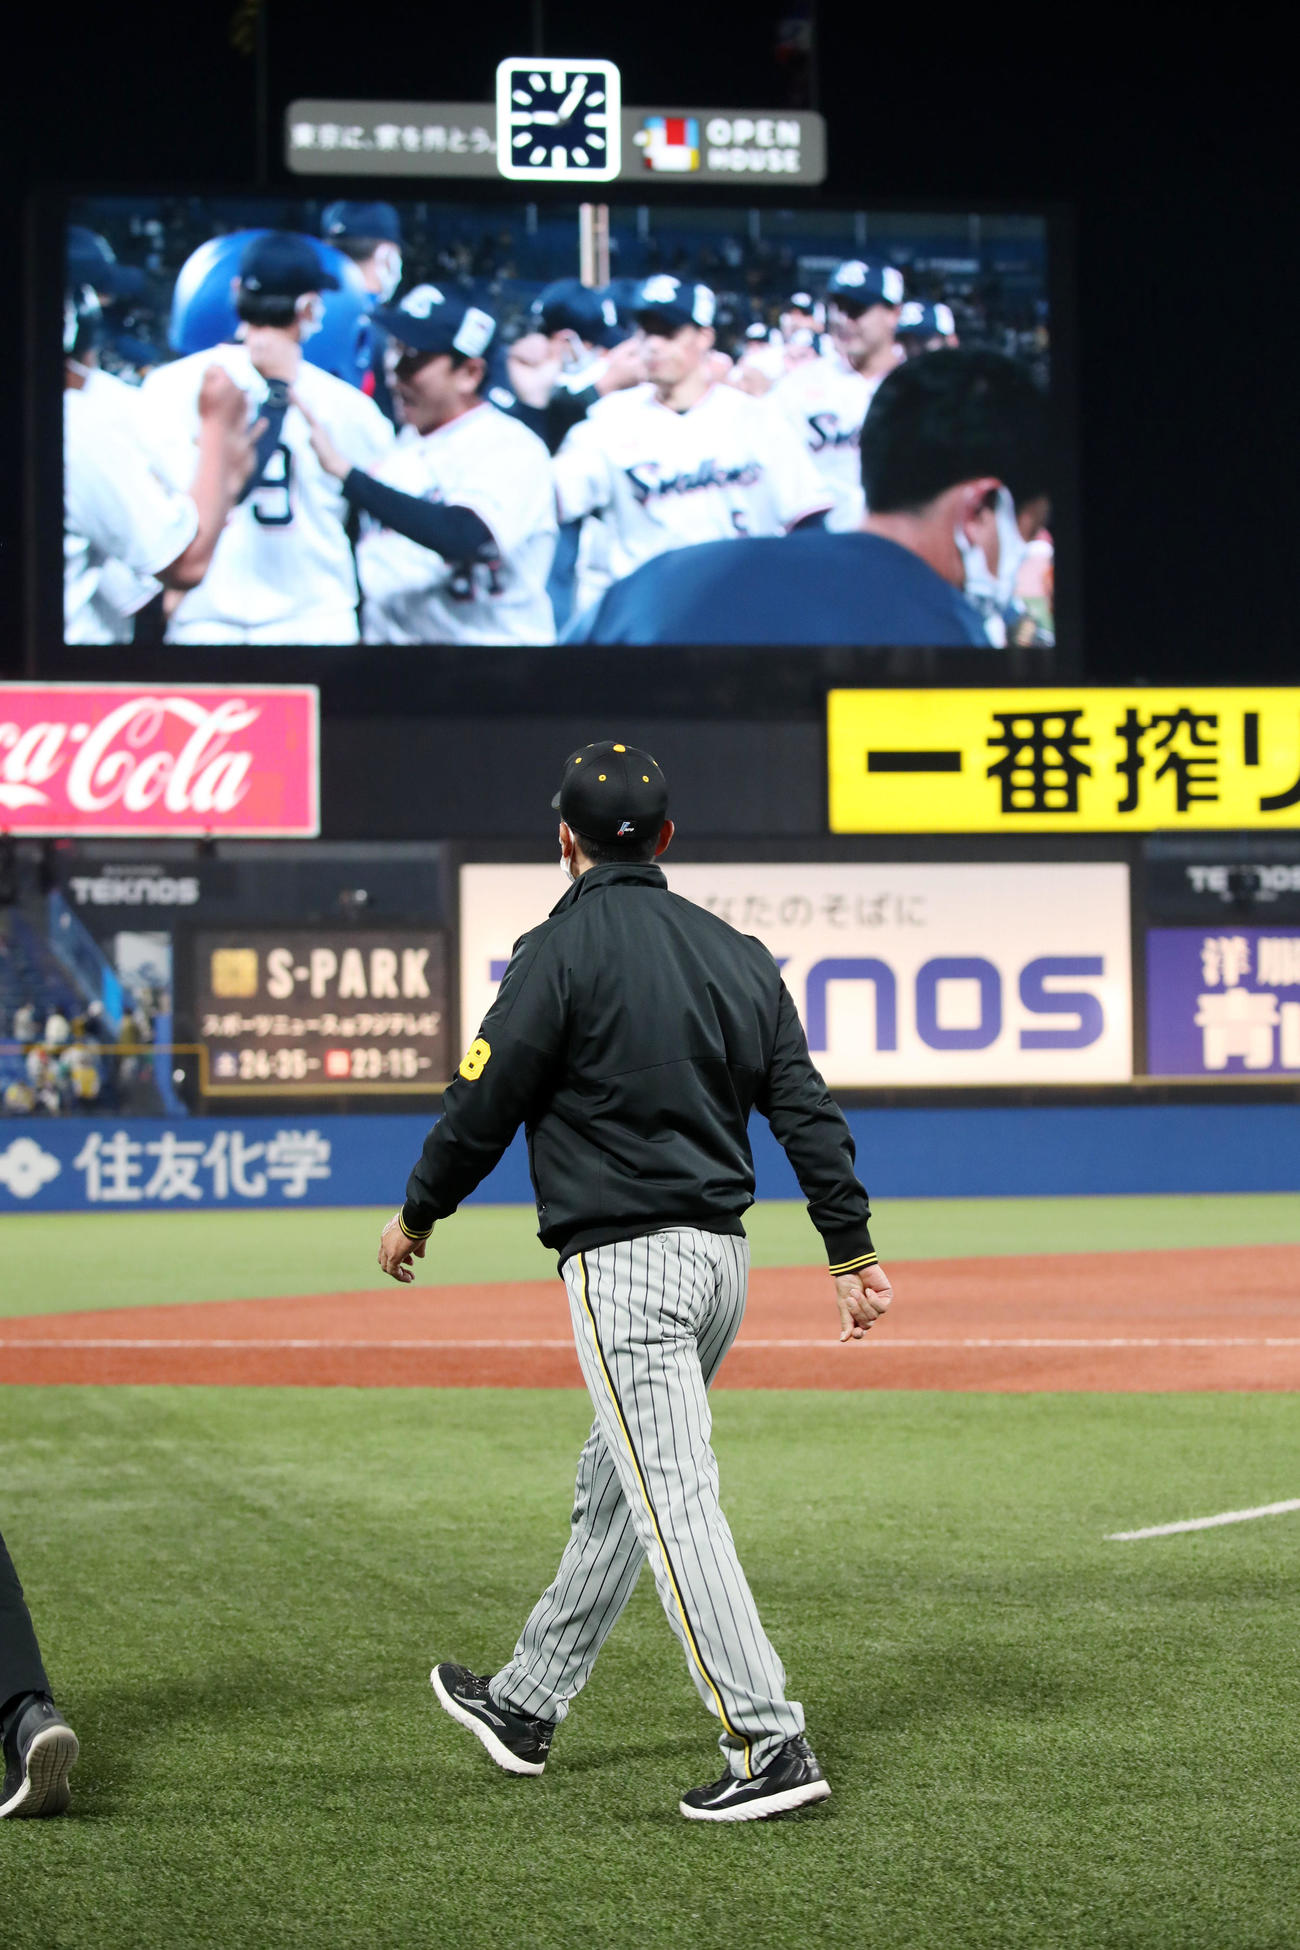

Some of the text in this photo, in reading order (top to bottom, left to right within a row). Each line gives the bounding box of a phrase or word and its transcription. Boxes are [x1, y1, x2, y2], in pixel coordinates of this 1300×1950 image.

[706, 118, 801, 147] OPEN
[707, 147, 801, 173] HOUSE
[266, 948, 431, 999] S-PARK
[459, 1037, 492, 1081] 8
[73, 1130, 332, 1201] 住友化学
